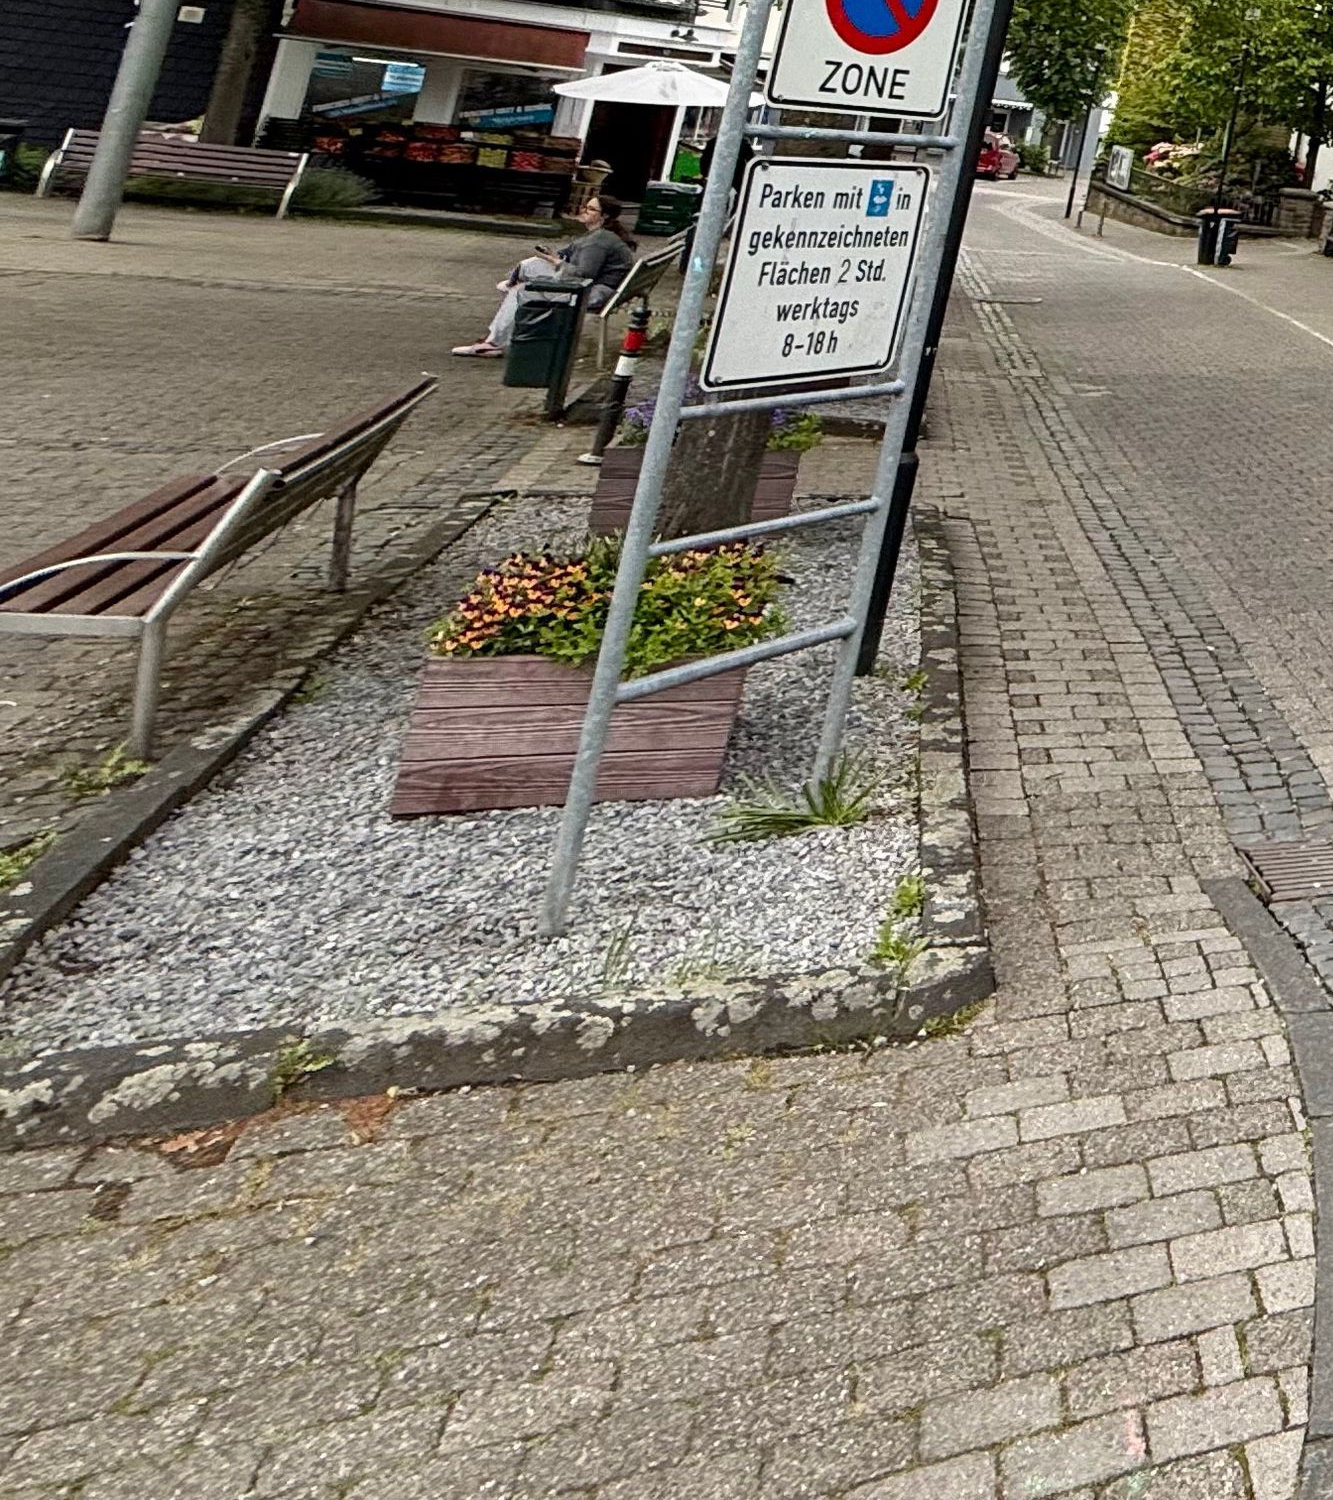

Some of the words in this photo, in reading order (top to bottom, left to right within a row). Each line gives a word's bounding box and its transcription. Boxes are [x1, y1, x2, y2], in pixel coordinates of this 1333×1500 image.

[818, 60, 911, 100] ZONE
[758, 183, 826, 209] Parken
[832, 186, 864, 209] mit
[895, 187, 912, 210] in
[748, 224, 910, 257] gekennzeichneten
[758, 261, 831, 287] Flächen
[837, 259, 851, 284] 2
[855, 259, 887, 283] Std.
[776, 296, 860, 324] werktags
